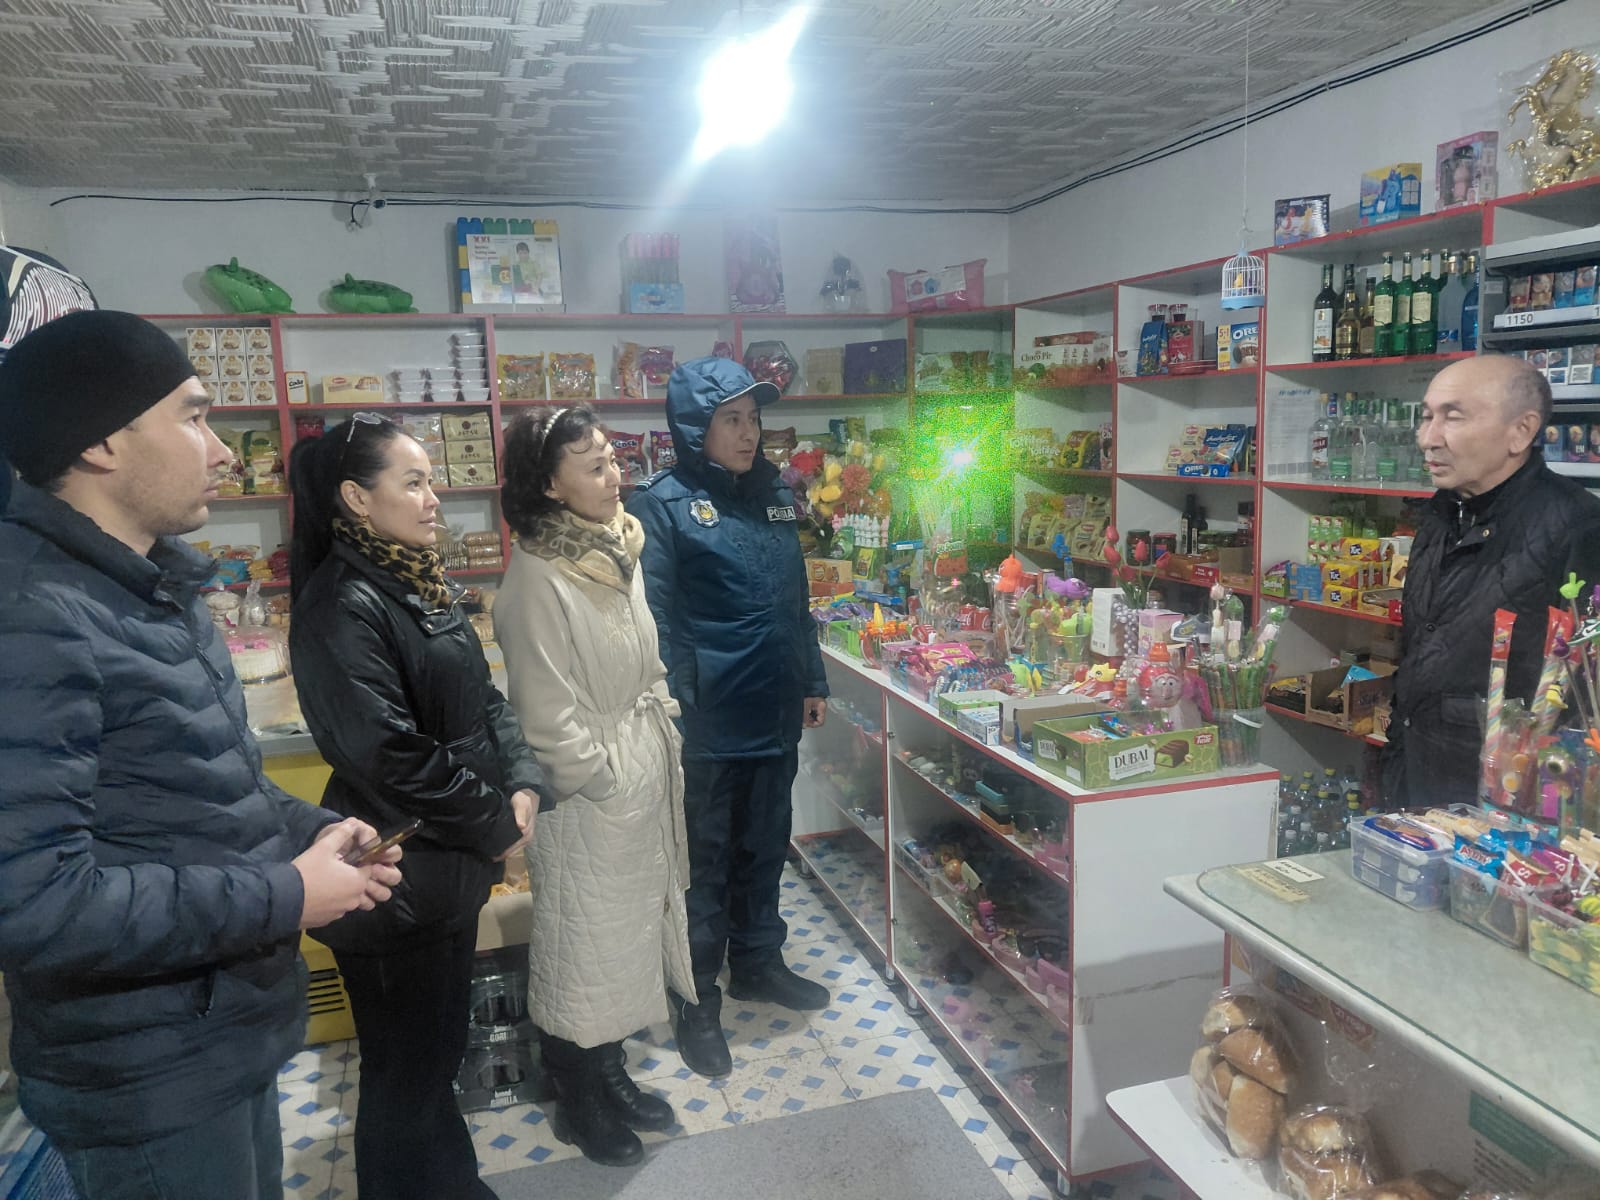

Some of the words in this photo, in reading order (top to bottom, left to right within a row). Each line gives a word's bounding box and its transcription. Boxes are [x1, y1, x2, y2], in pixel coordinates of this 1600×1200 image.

[1507, 313, 1534, 325] 1150
[1232, 327, 1258, 340] ORE
[1114, 748, 1148, 769] DUBAI
